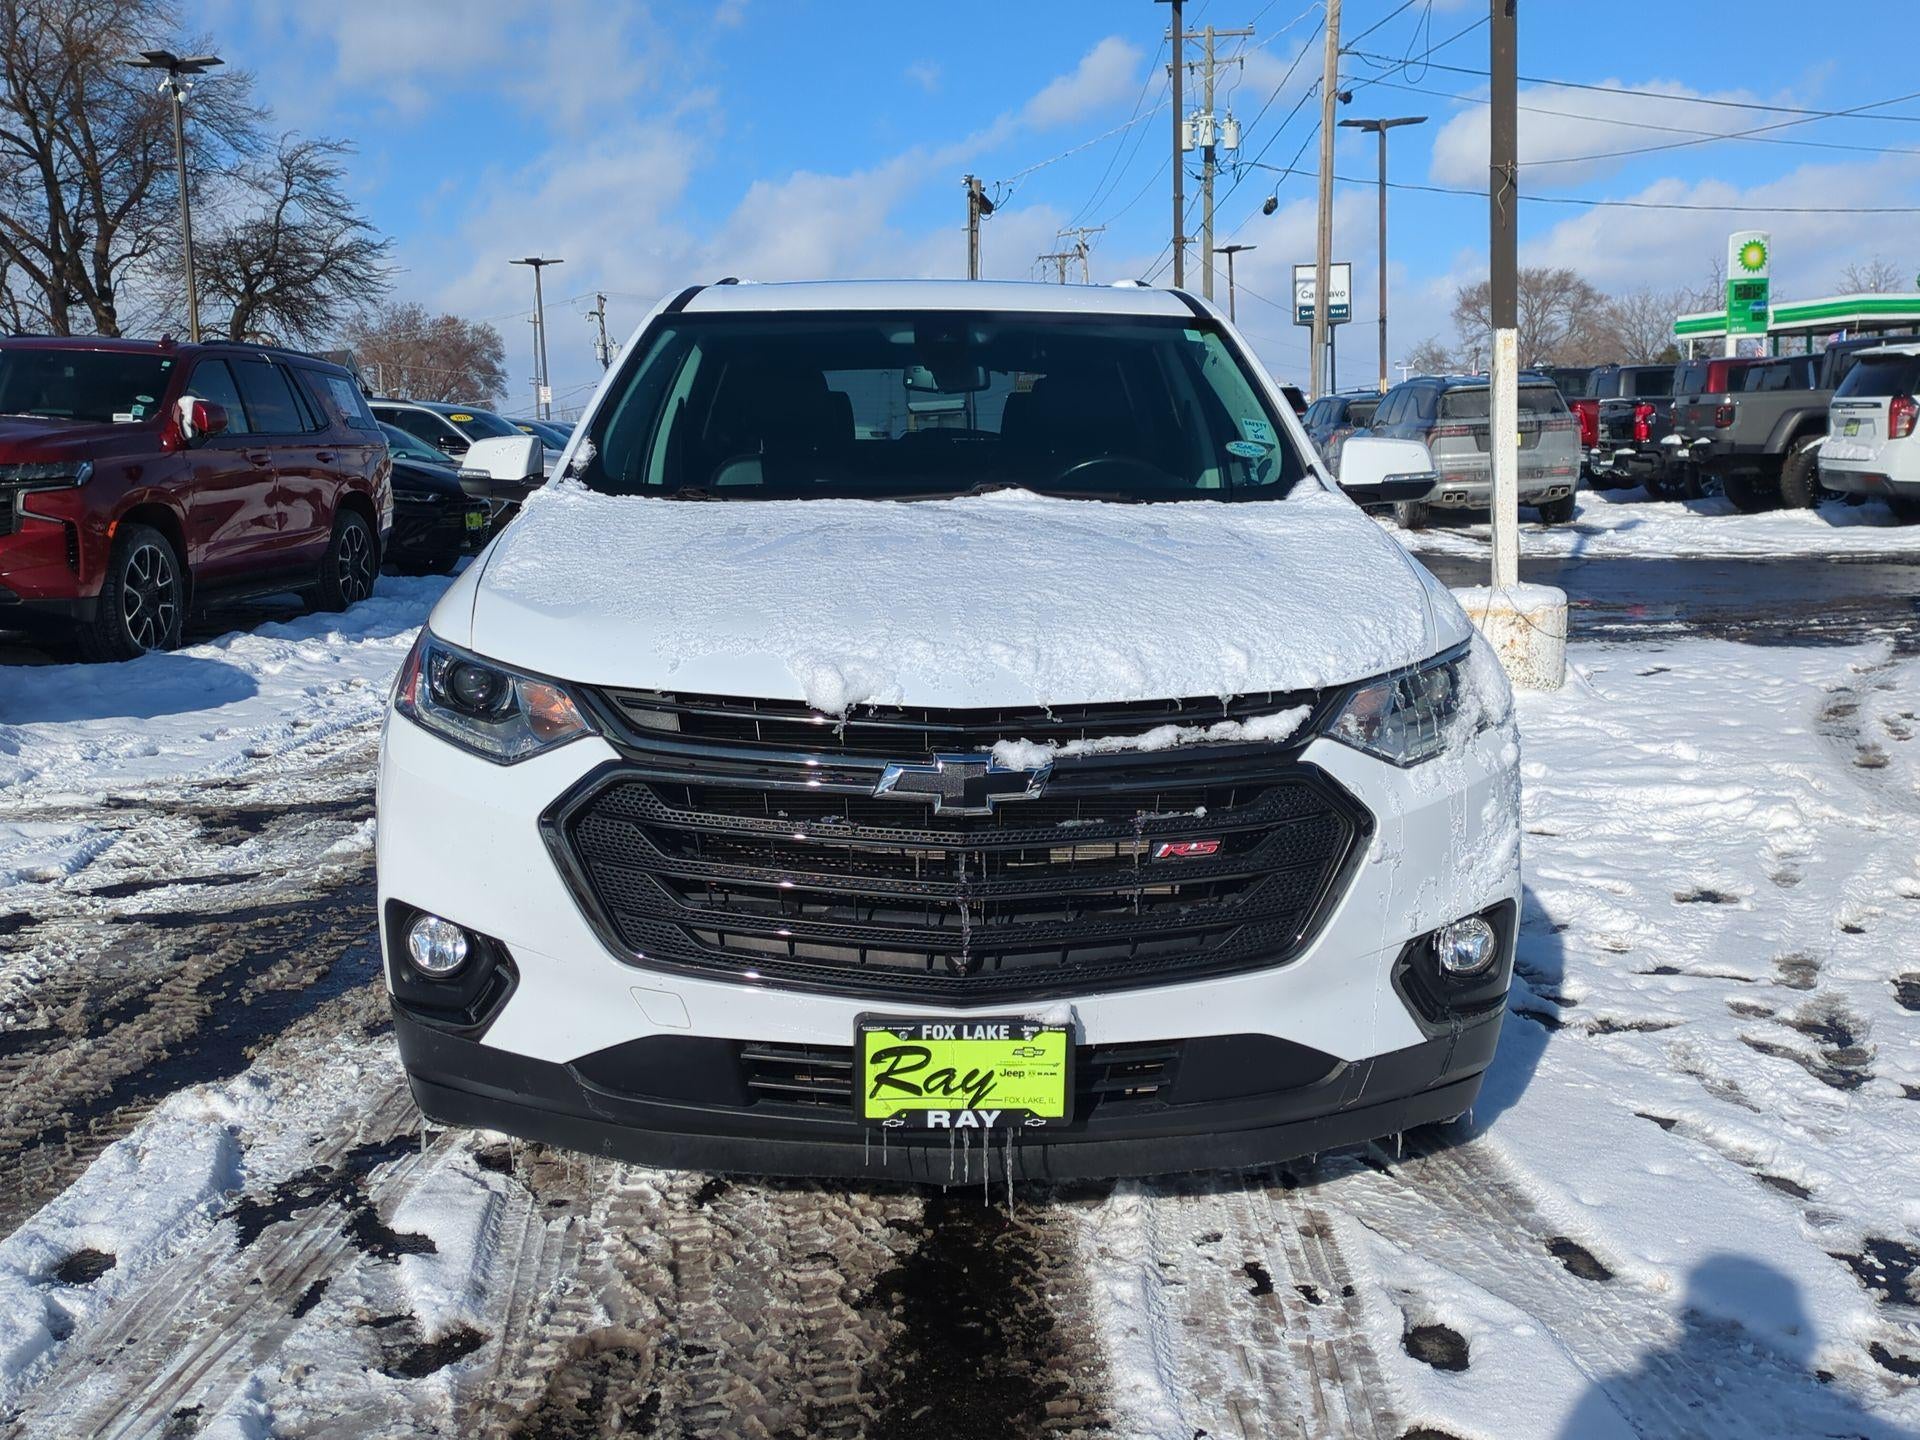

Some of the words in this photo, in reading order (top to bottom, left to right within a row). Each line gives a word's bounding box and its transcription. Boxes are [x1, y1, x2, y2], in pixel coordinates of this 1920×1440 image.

[1155, 841, 1221, 858] RS
[922, 1025, 954, 1040] FOX
[962, 1024, 1010, 1040] LAKE
[869, 1046, 998, 1110] Ray
[999, 1068, 1025, 1079] Jeep
[1004, 1096, 1021, 1104] FOX
[1023, 1096, 1047, 1105] LAKE,
[927, 1110, 1002, 1129] RAY
